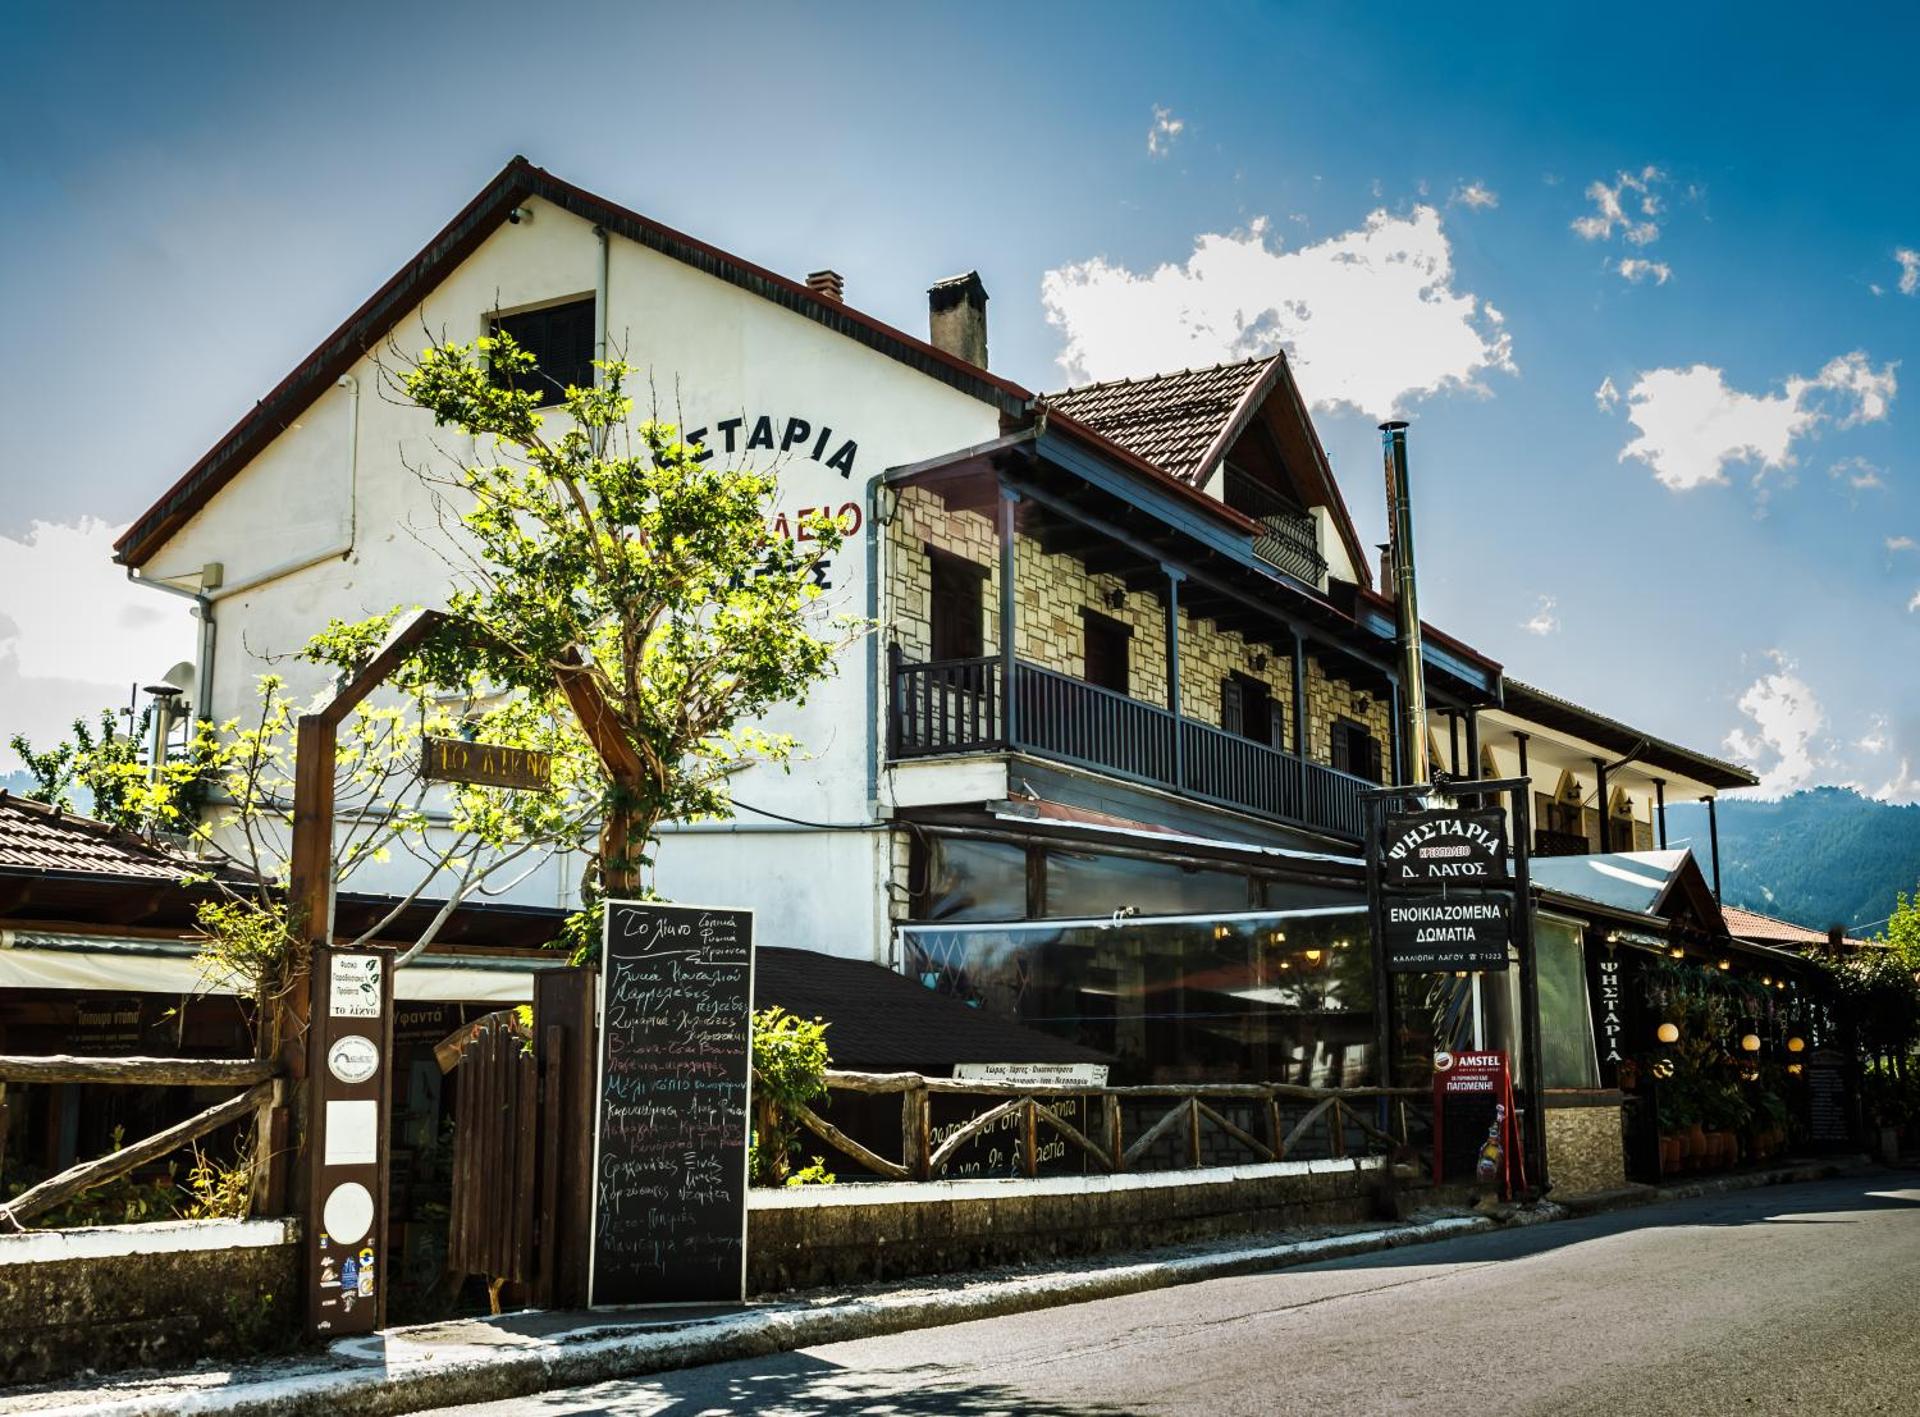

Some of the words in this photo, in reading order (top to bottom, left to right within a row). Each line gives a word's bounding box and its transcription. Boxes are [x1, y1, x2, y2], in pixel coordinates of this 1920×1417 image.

[1388, 819, 1500, 860] ΨΗΣΤΑΡΙΑ
[1402, 865, 1420, 877] Δ.
[1428, 862, 1488, 877] ΛΑΓΟΣ
[1390, 904, 1501, 923] ΕΝΟΙΚΙΑΖΟΜΕΝΑ
[1416, 927, 1476, 942] ΔΩΜΑΤΙΑ
[1600, 962, 1623, 1061] ΨΗΣΤΑΡΙΑ
[1458, 1055, 1501, 1066] AMSTEL
